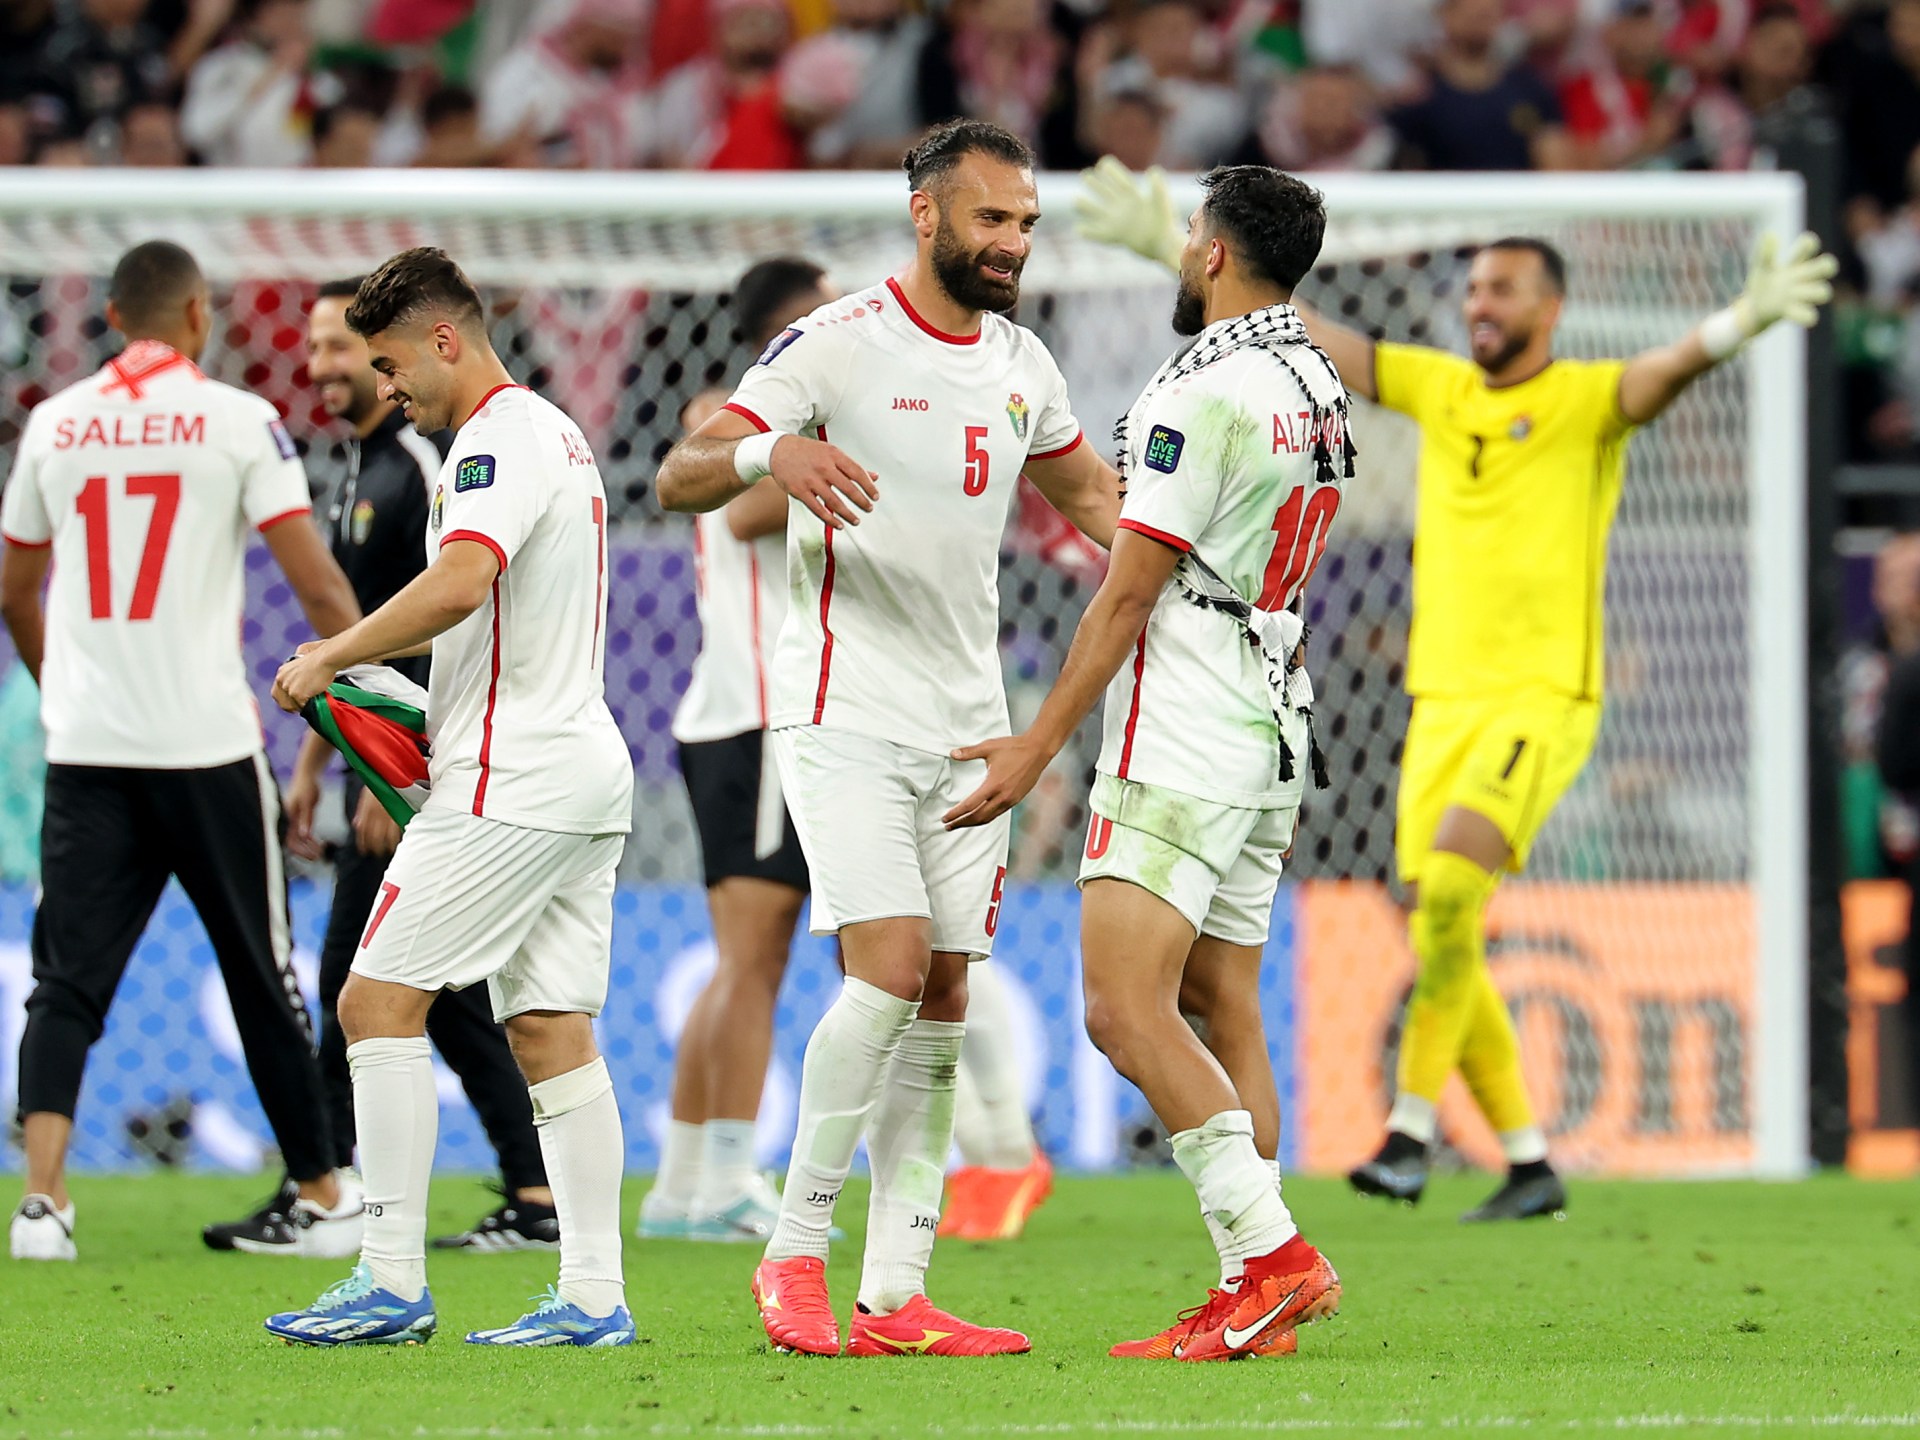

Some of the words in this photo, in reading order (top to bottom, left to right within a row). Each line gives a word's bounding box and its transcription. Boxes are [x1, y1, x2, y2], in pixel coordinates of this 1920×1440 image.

[892, 398, 929, 411] JAKO
[54, 415, 206, 450] SALEM
[1150, 438, 1177, 457] LIVE
[1154, 431, 1170, 442] AFC
[460, 465, 489, 479] LIVE
[461, 460, 478, 470] AFC
[963, 426, 990, 497] 5
[76, 473, 182, 621] 17
[1253, 485, 1340, 613] 10
[1501, 738, 1527, 781] 1
[361, 880, 401, 950] 7
[985, 865, 1007, 938] 5
